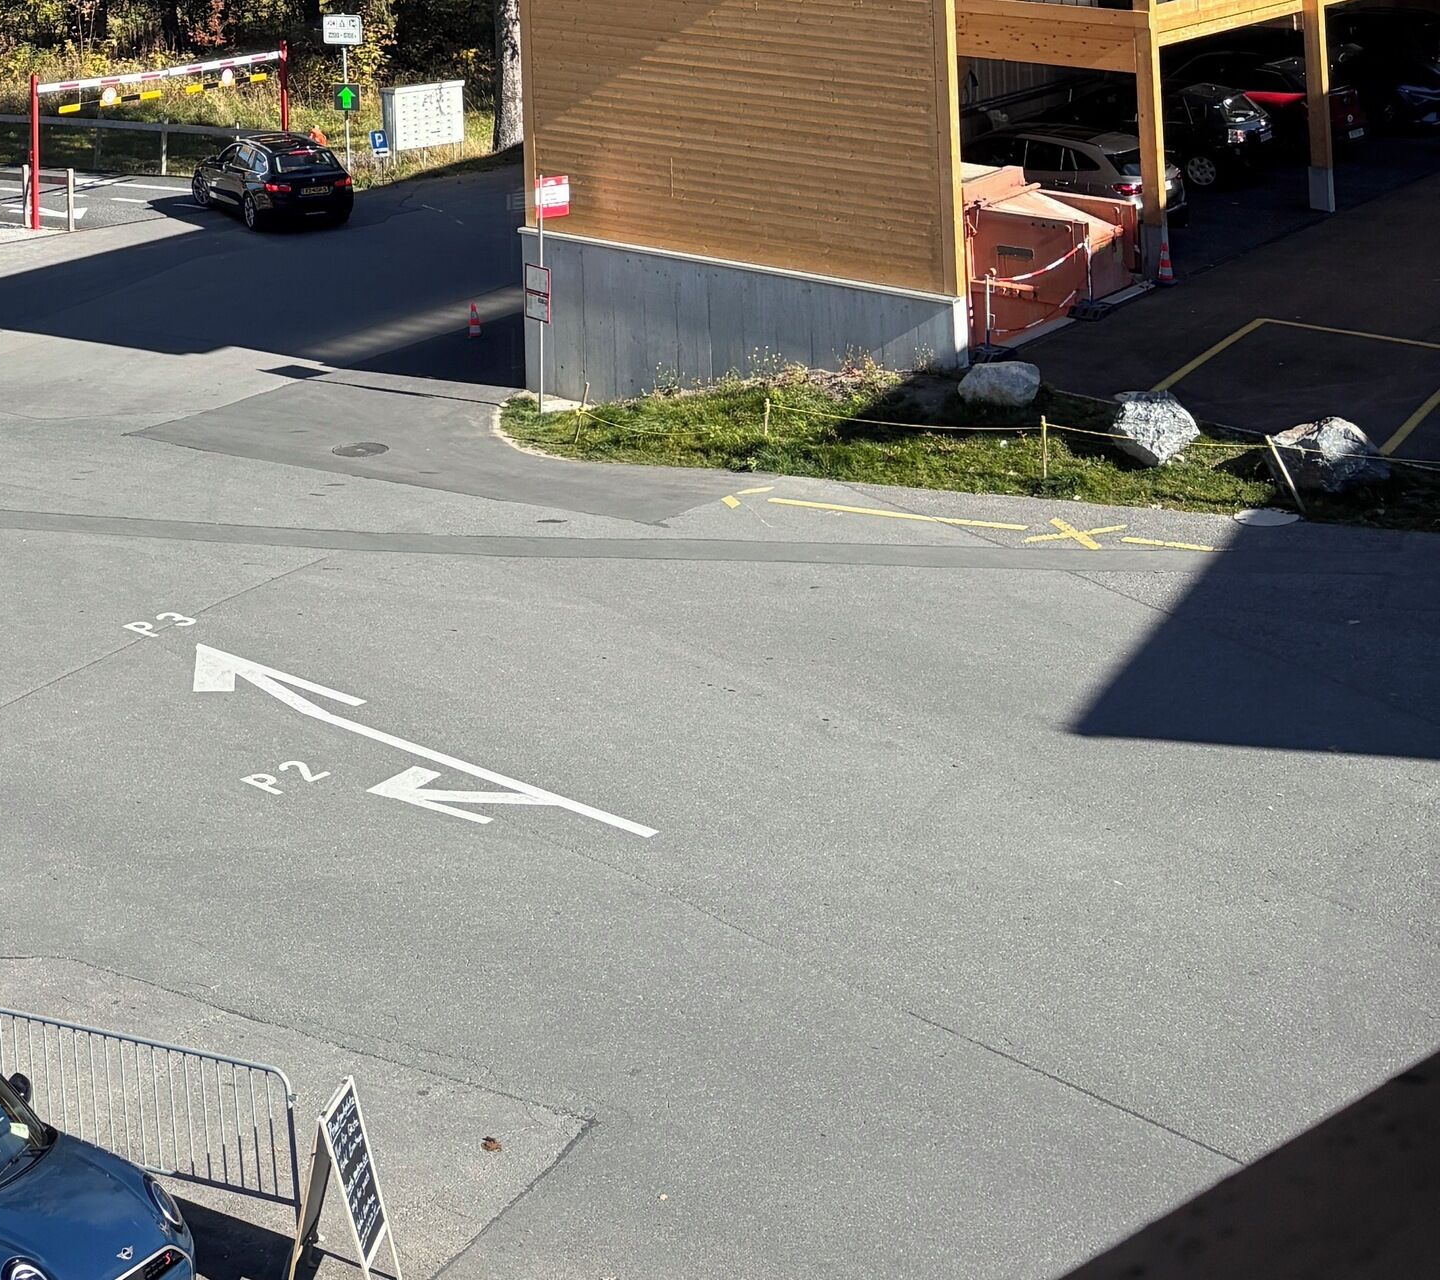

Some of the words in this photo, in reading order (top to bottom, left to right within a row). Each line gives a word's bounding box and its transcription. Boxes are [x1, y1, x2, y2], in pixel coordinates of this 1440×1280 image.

[375, 133, 383, 147] P
[122, 611, 198, 638] P3
[240, 760, 331, 796] P2
